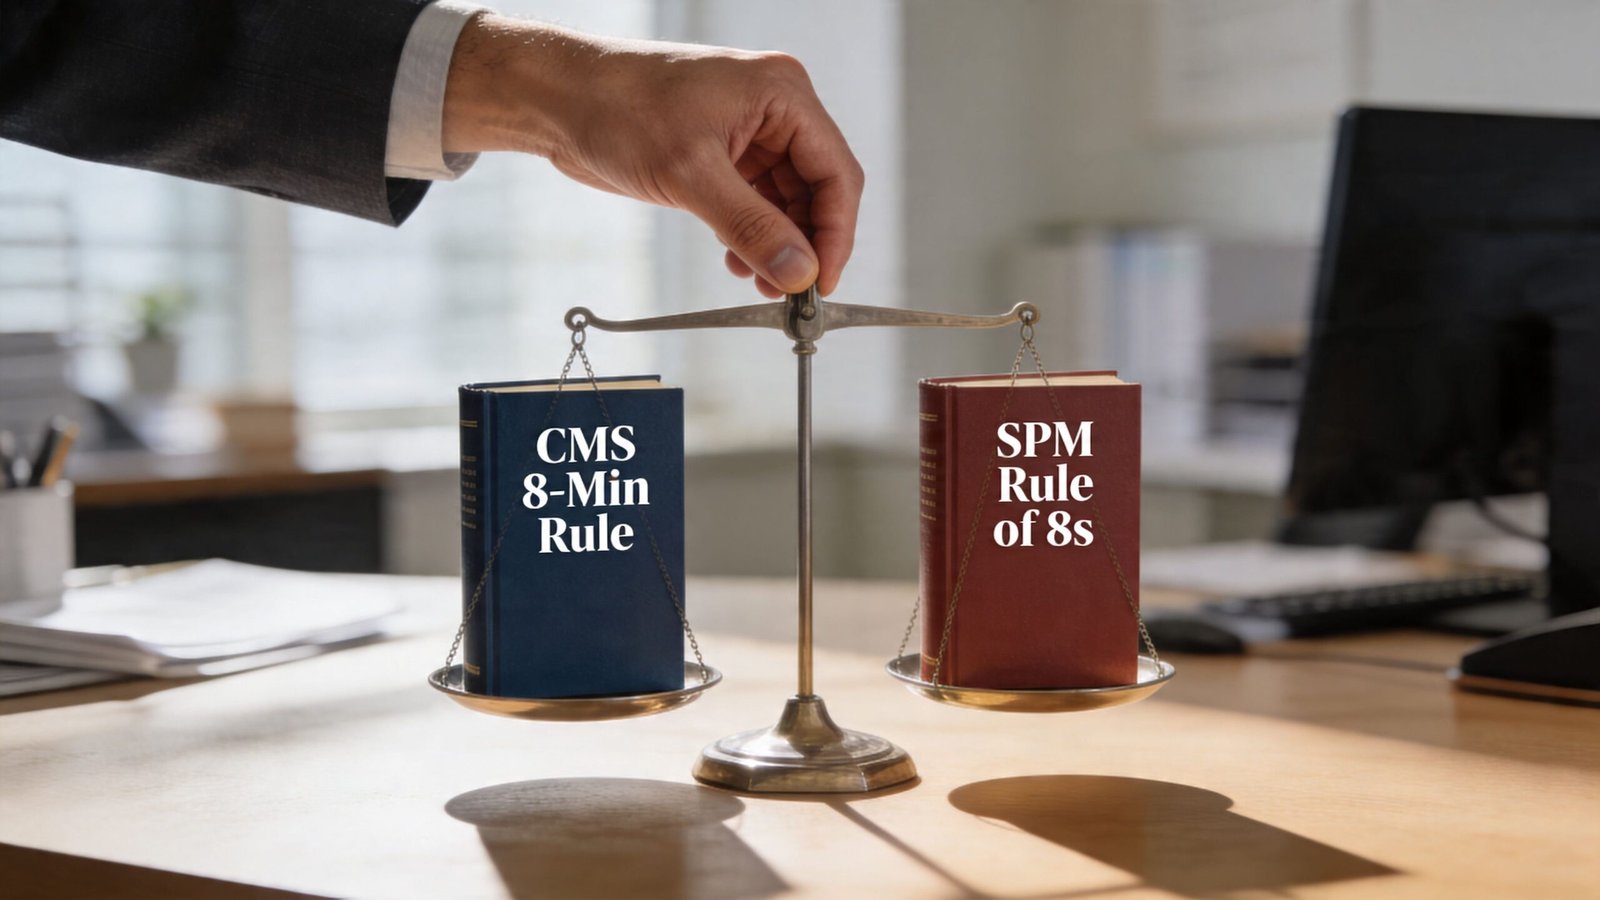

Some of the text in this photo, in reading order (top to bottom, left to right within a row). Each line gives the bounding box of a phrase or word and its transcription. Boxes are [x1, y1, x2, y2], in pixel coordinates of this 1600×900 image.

[536, 425, 636, 463] CMS
[997, 421, 1093, 458] SPM
[522, 468, 650, 509] 8-Min
[998, 463, 1094, 503] Rule
[538, 513, 634, 553] Rule
[993, 509, 1094, 548] of 8s
